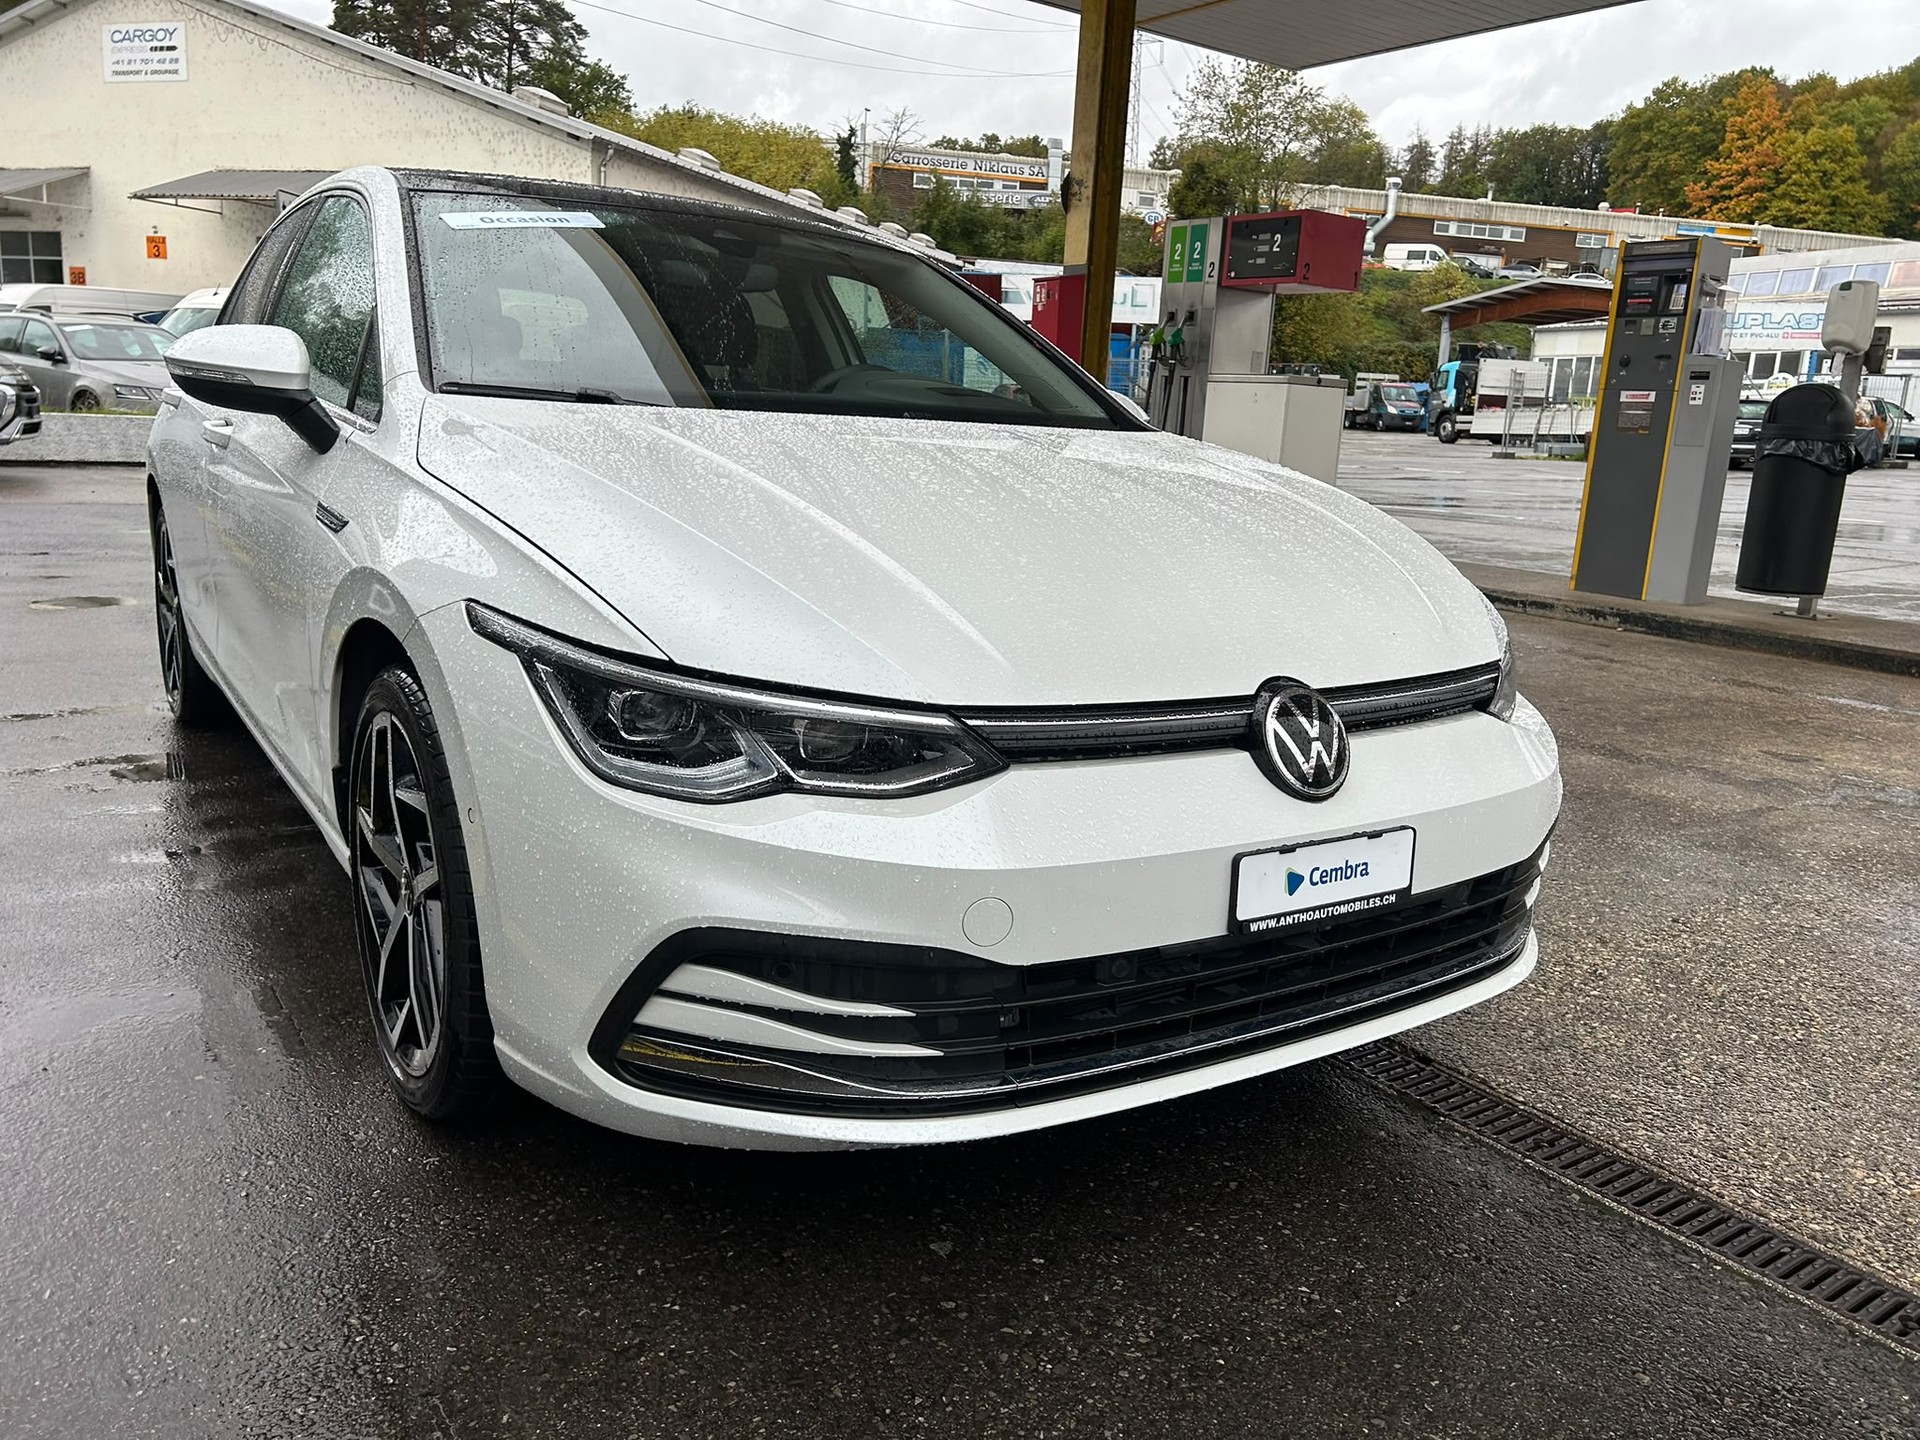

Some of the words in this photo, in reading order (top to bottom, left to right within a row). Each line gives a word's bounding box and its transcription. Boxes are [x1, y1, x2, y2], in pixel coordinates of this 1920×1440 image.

[110, 27, 178, 43] CARGOY
[112, 69, 143, 77] TRANSPORT
[891, 151, 968, 170] Carrosserie
[973, 160, 1025, 176] Niklaus
[1028, 165, 1046, 178] SA
[479, 216, 571, 224] Occasion
[153, 245, 160, 257] 3
[1193, 241, 1201, 259] 2
[1272, 233, 1281, 252] 2
[1174, 243, 1182, 260] 2
[70, 271, 86, 285] 3B
[1208, 261, 1216, 278] 2
[1303, 263, 1310, 280] 2
[1353, 271, 1358, 288] 1
[1309, 859, 1370, 887] Cembra
[1250, 893, 1396, 933] WWW.ANTHOAUTOMOBILES.CH
